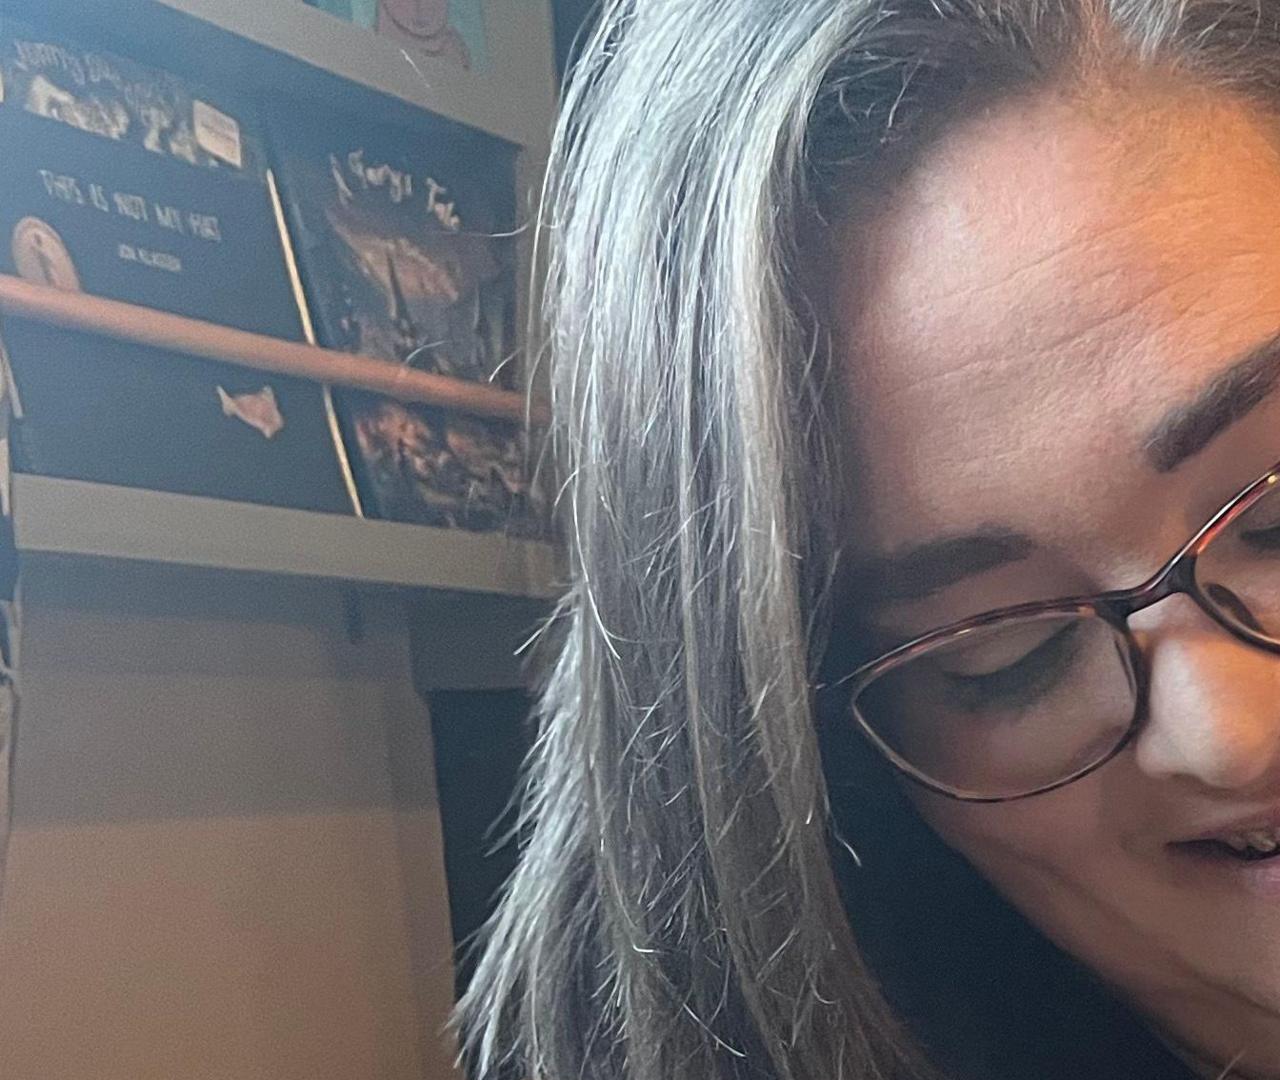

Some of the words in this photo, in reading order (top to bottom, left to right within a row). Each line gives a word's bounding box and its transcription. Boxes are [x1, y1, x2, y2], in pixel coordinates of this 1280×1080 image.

[38, 169, 84, 205] THIS
[89, 183, 109, 212] IS
[113, 192, 149, 222] NOT
[154, 203, 185, 235] MY
[188, 212, 222, 241] HAT
